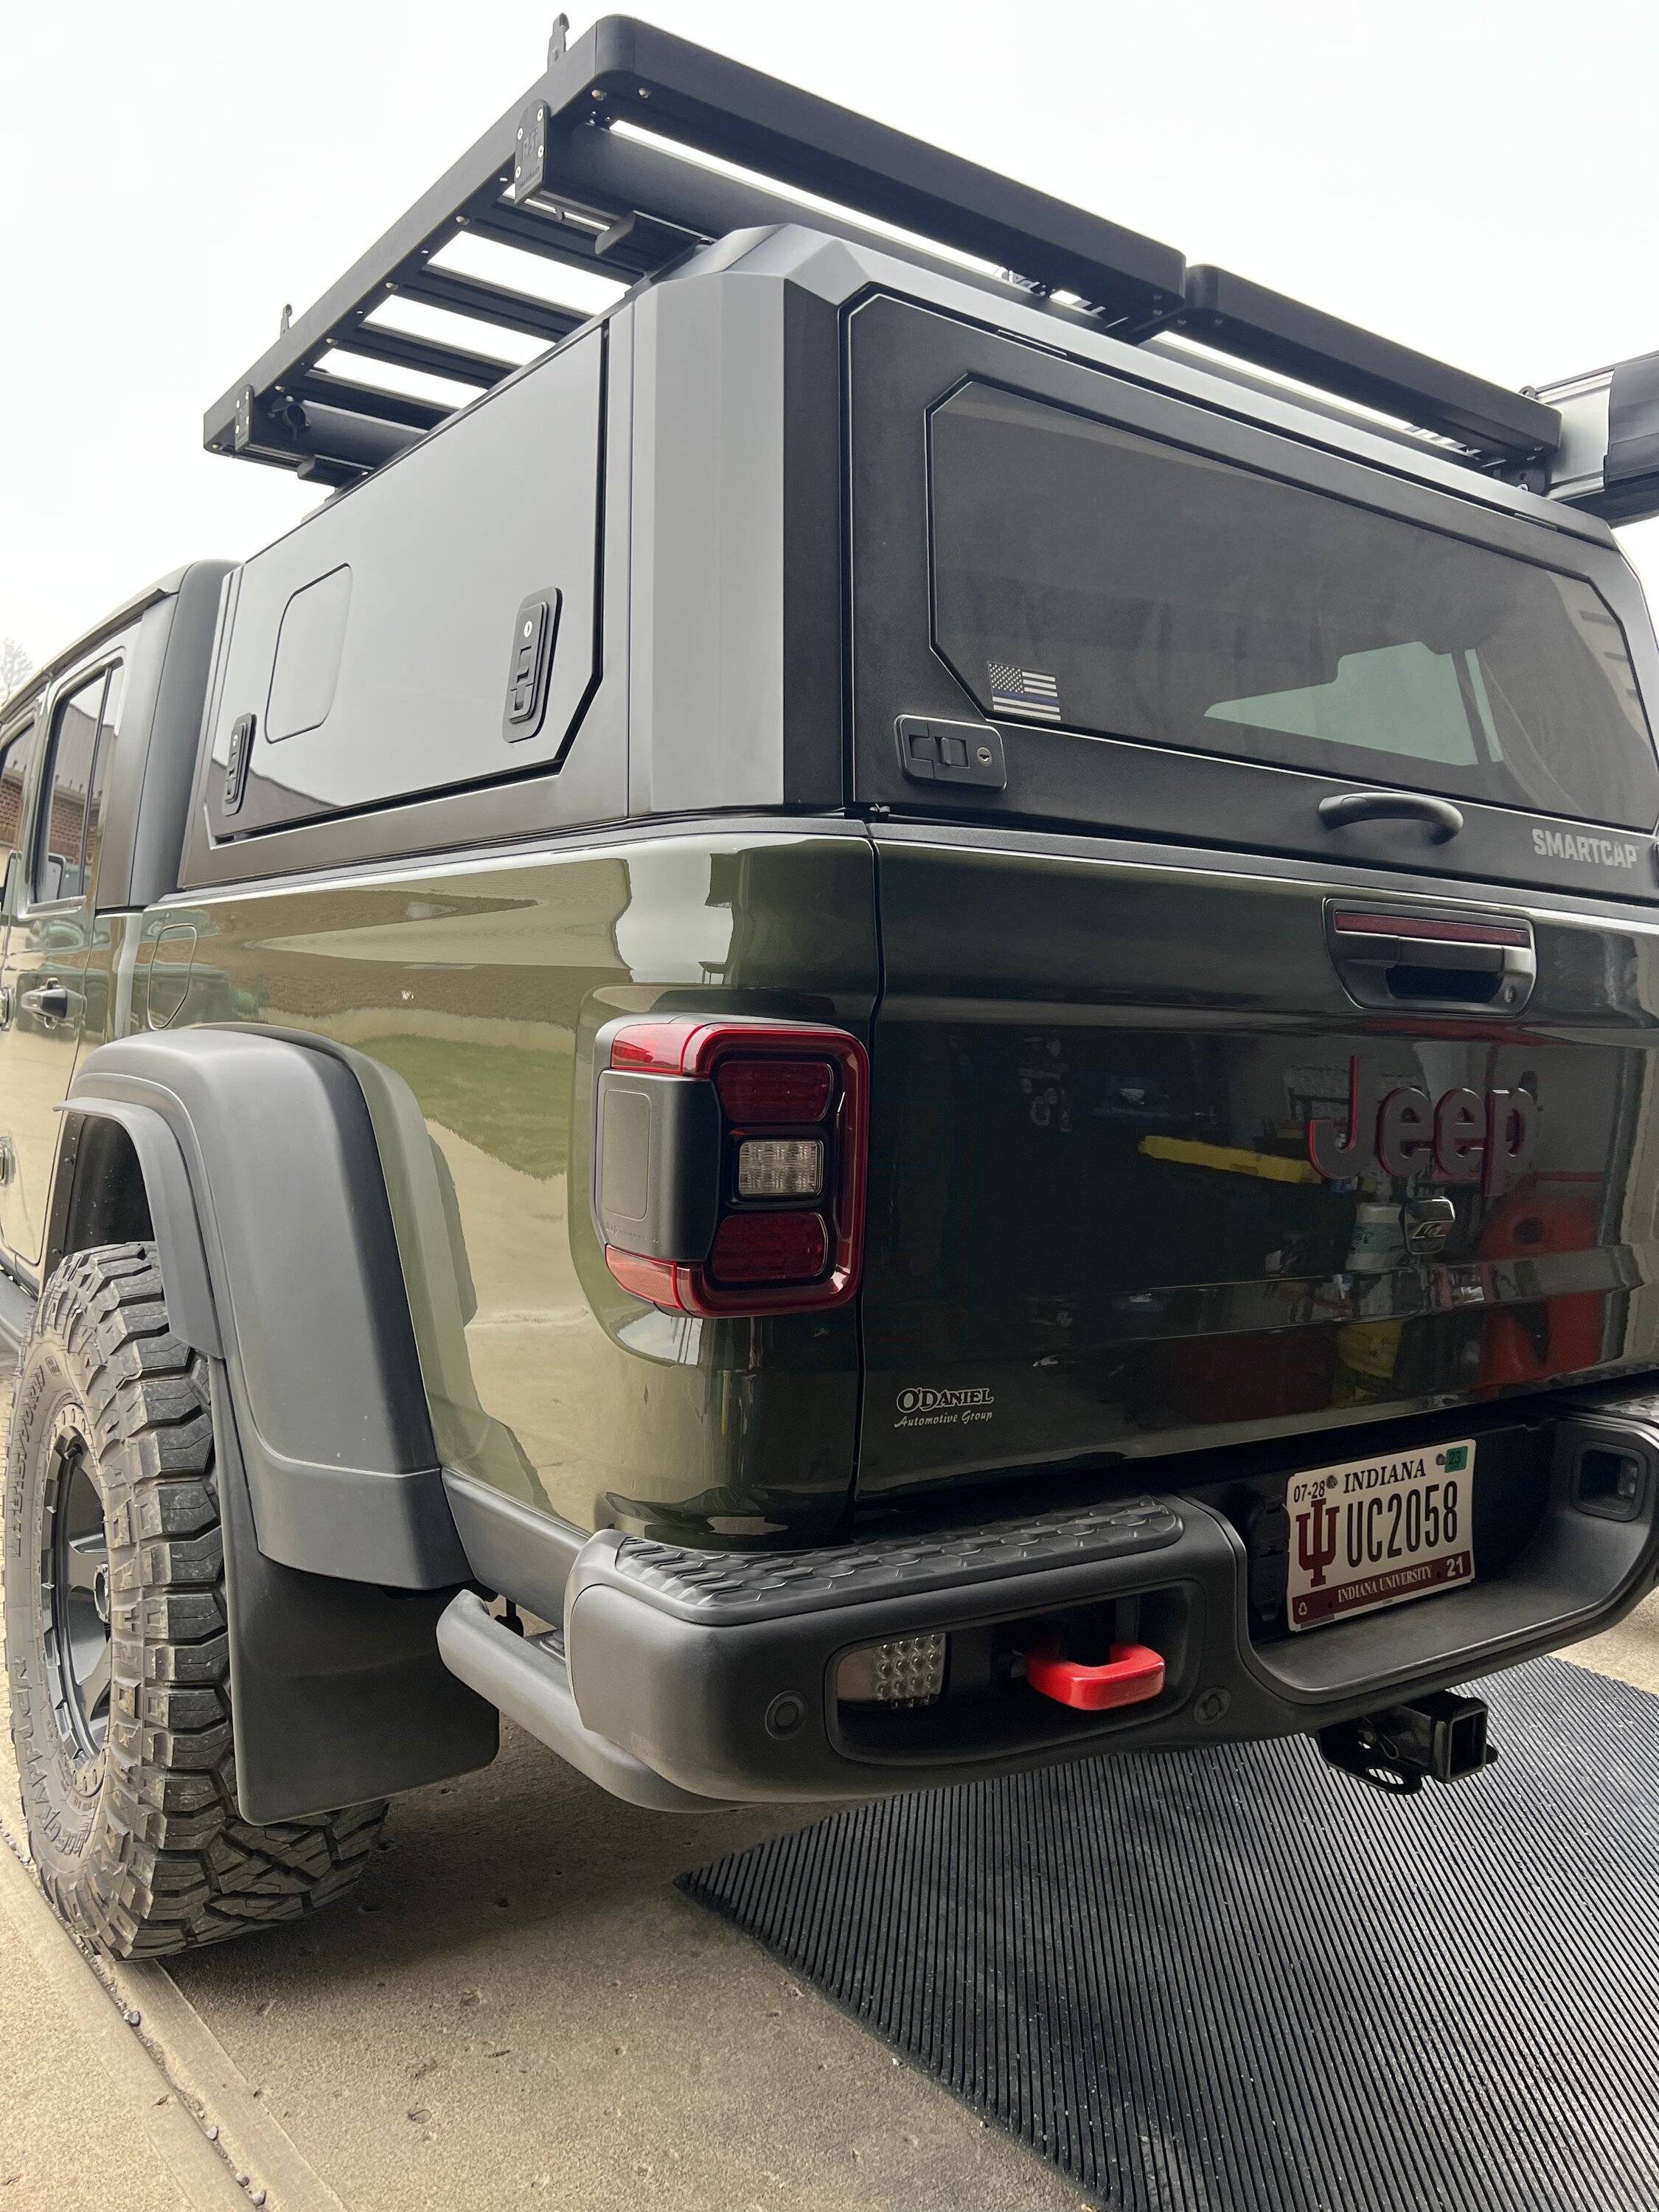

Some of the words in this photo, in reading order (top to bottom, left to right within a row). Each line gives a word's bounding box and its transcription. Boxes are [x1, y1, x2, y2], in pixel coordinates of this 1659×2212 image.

[1531, 827, 1638, 869] SMARTCAP
[1307, 1054, 1535, 1197] Jeep
[894, 1412, 959, 1428] Automotive
[961, 1409, 992, 1425] Group
[1293, 1480, 1326, 1503] 07-28
[1343, 1458, 1427, 1494] INDIANA
[1346, 1481, 1458, 1568] UC2058
[1338, 1579, 1378, 1603] INDIANA
[1379, 1565, 1433, 1592] UNIVERSITY
[1446, 1555, 1464, 1577] 21
